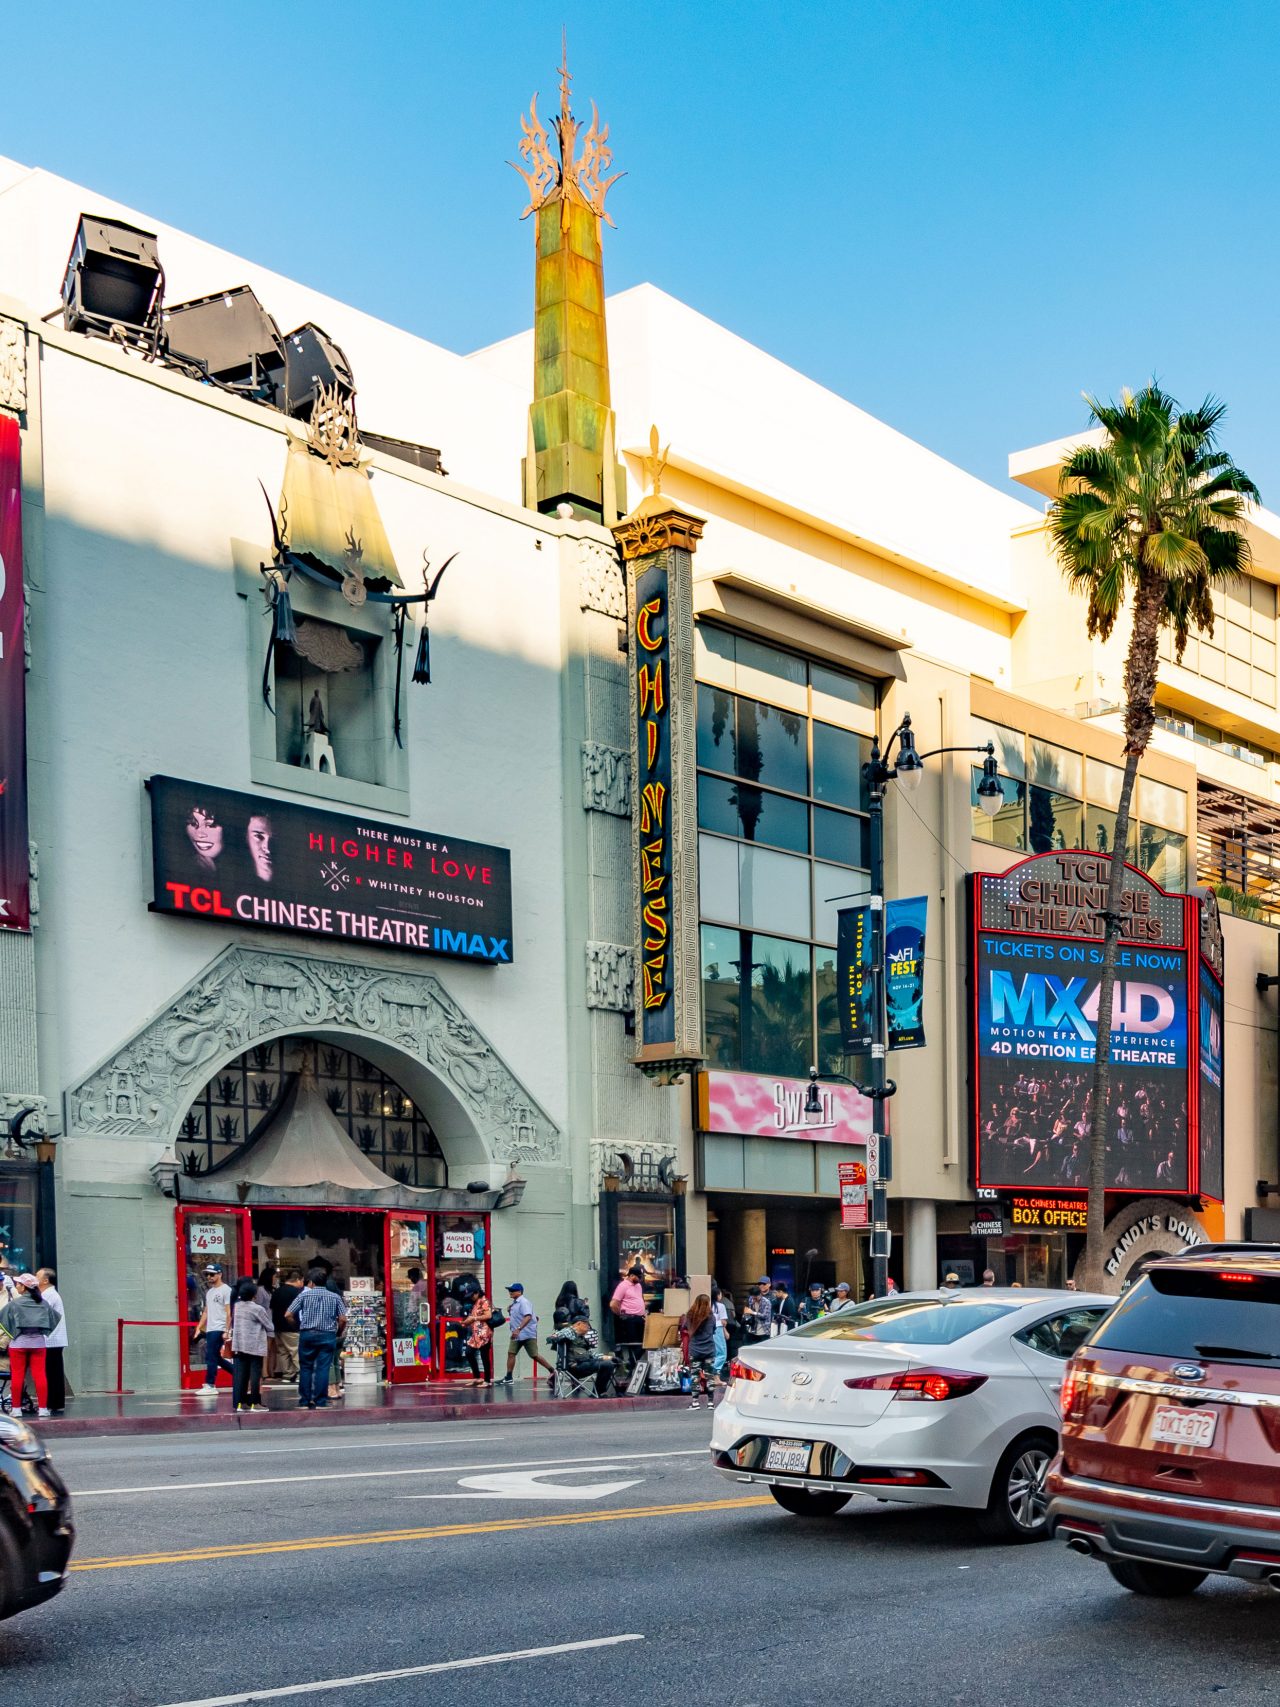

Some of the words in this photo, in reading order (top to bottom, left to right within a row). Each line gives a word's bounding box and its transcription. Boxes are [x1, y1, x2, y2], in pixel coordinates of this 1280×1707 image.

[636, 598, 667, 1010] CHINESE
[357, 827, 389, 841] THERE
[393, 835, 421, 848] MUST
[426, 842, 437, 851] BE
[442, 845, 448, 853] A
[309, 832, 413, 869] HIGHER
[431, 857, 492, 885] LOVE
[1058, 857, 1111, 884] TCL
[368, 879, 423, 896] WHITNEY
[428, 890, 484, 908] HOUSTON
[165, 881, 232, 917] TCL
[236, 894, 333, 932] CHINESE
[336, 911, 430, 948] THEATRE
[434, 927, 510, 960] IMAX
[896, 947, 913, 962] AFI
[984, 939, 1054, 960] TICKETS
[1059, 946, 1084, 963] ON
[1135, 953, 1181, 971] NOW!
[890, 960, 917, 976] FEST
[990, 1027, 1046, 1039] MOTION
[1053, 1031, 1077, 1040] EFX
[991, 1041, 1012, 1055] 4D
[1016, 1043, 1076, 1058] MOTION
[1112, 1049, 1176, 1064] THEATRE
[977, 1188, 998, 1198] TCL
[1013, 1198, 1029, 1207] TCL
[1030, 1199, 1056, 1209] CHINESE
[1057, 1200, 1088, 1211] THEATRES
[977, 1221, 1002, 1229] CHINESE
[1013, 1208, 1040, 1225] BOX
[1044, 1209, 1087, 1226] OFFICE
[192, 1234, 223, 1249] $4.99
[446, 1243, 453, 1253] 4
[456, 1243, 473, 1254] $10
[622, 1239, 656, 1250] IMAX
[1106, 1215, 1161, 1276] RANDY'S
[394, 1340, 412, 1355] $4.99
[1175, 1366, 1198, 1377] Ford
